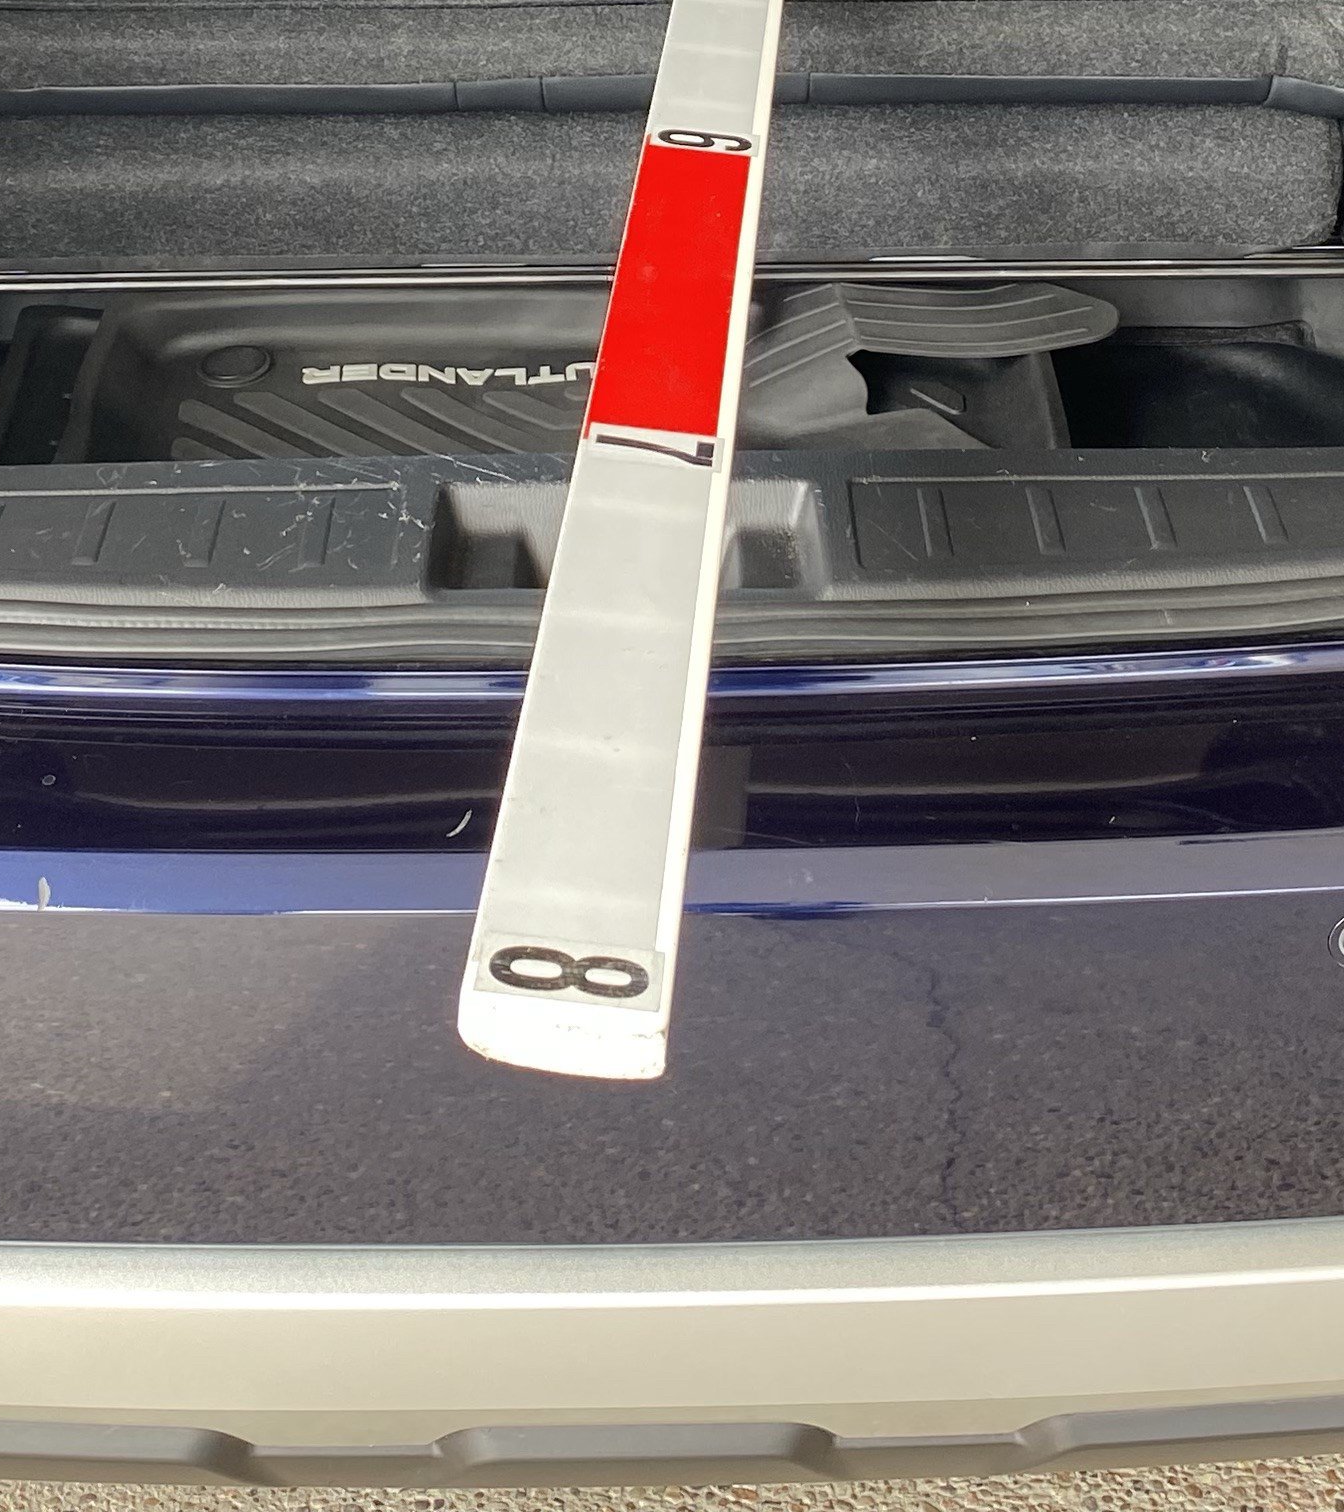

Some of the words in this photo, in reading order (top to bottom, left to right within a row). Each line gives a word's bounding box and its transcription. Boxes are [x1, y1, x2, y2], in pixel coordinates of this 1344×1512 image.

[301, 361, 597, 386] UTLANDER
[596, 434, 715, 467] 7
[489, 945, 650, 998] 8
